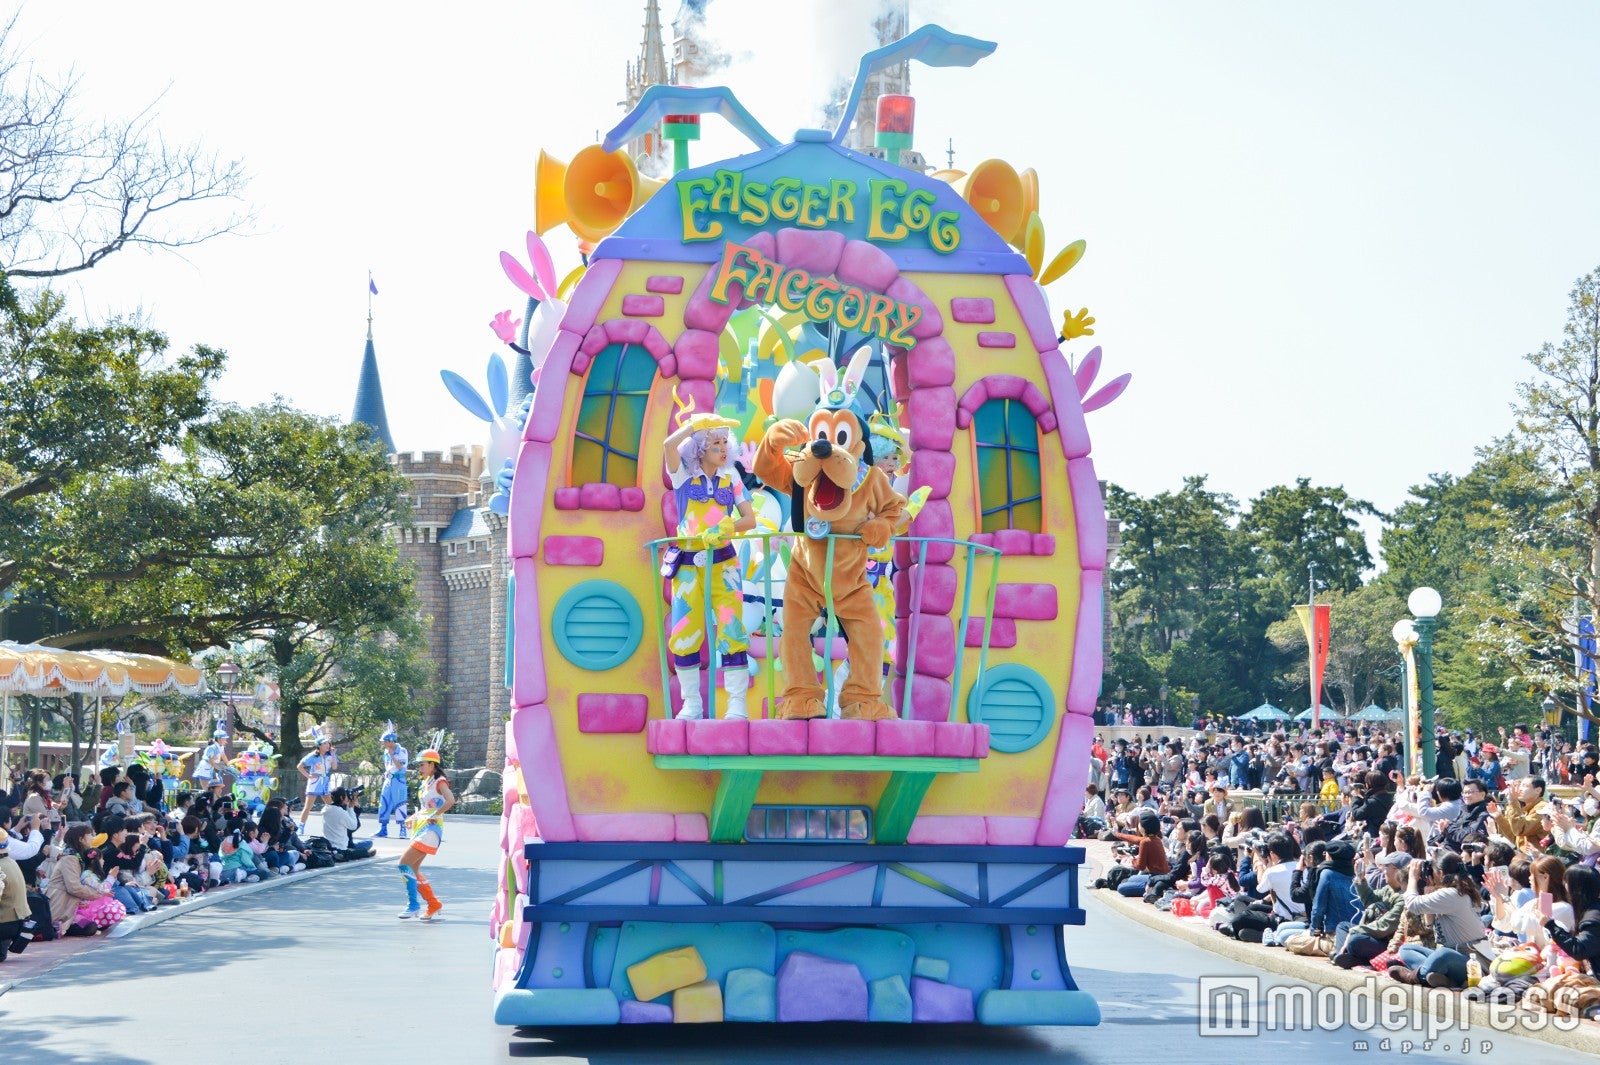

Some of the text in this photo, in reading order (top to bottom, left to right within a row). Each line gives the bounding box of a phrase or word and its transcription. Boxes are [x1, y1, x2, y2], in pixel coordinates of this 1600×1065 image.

[676, 168, 961, 255] EASTER EGG
[708, 241, 924, 350] FACTORY
